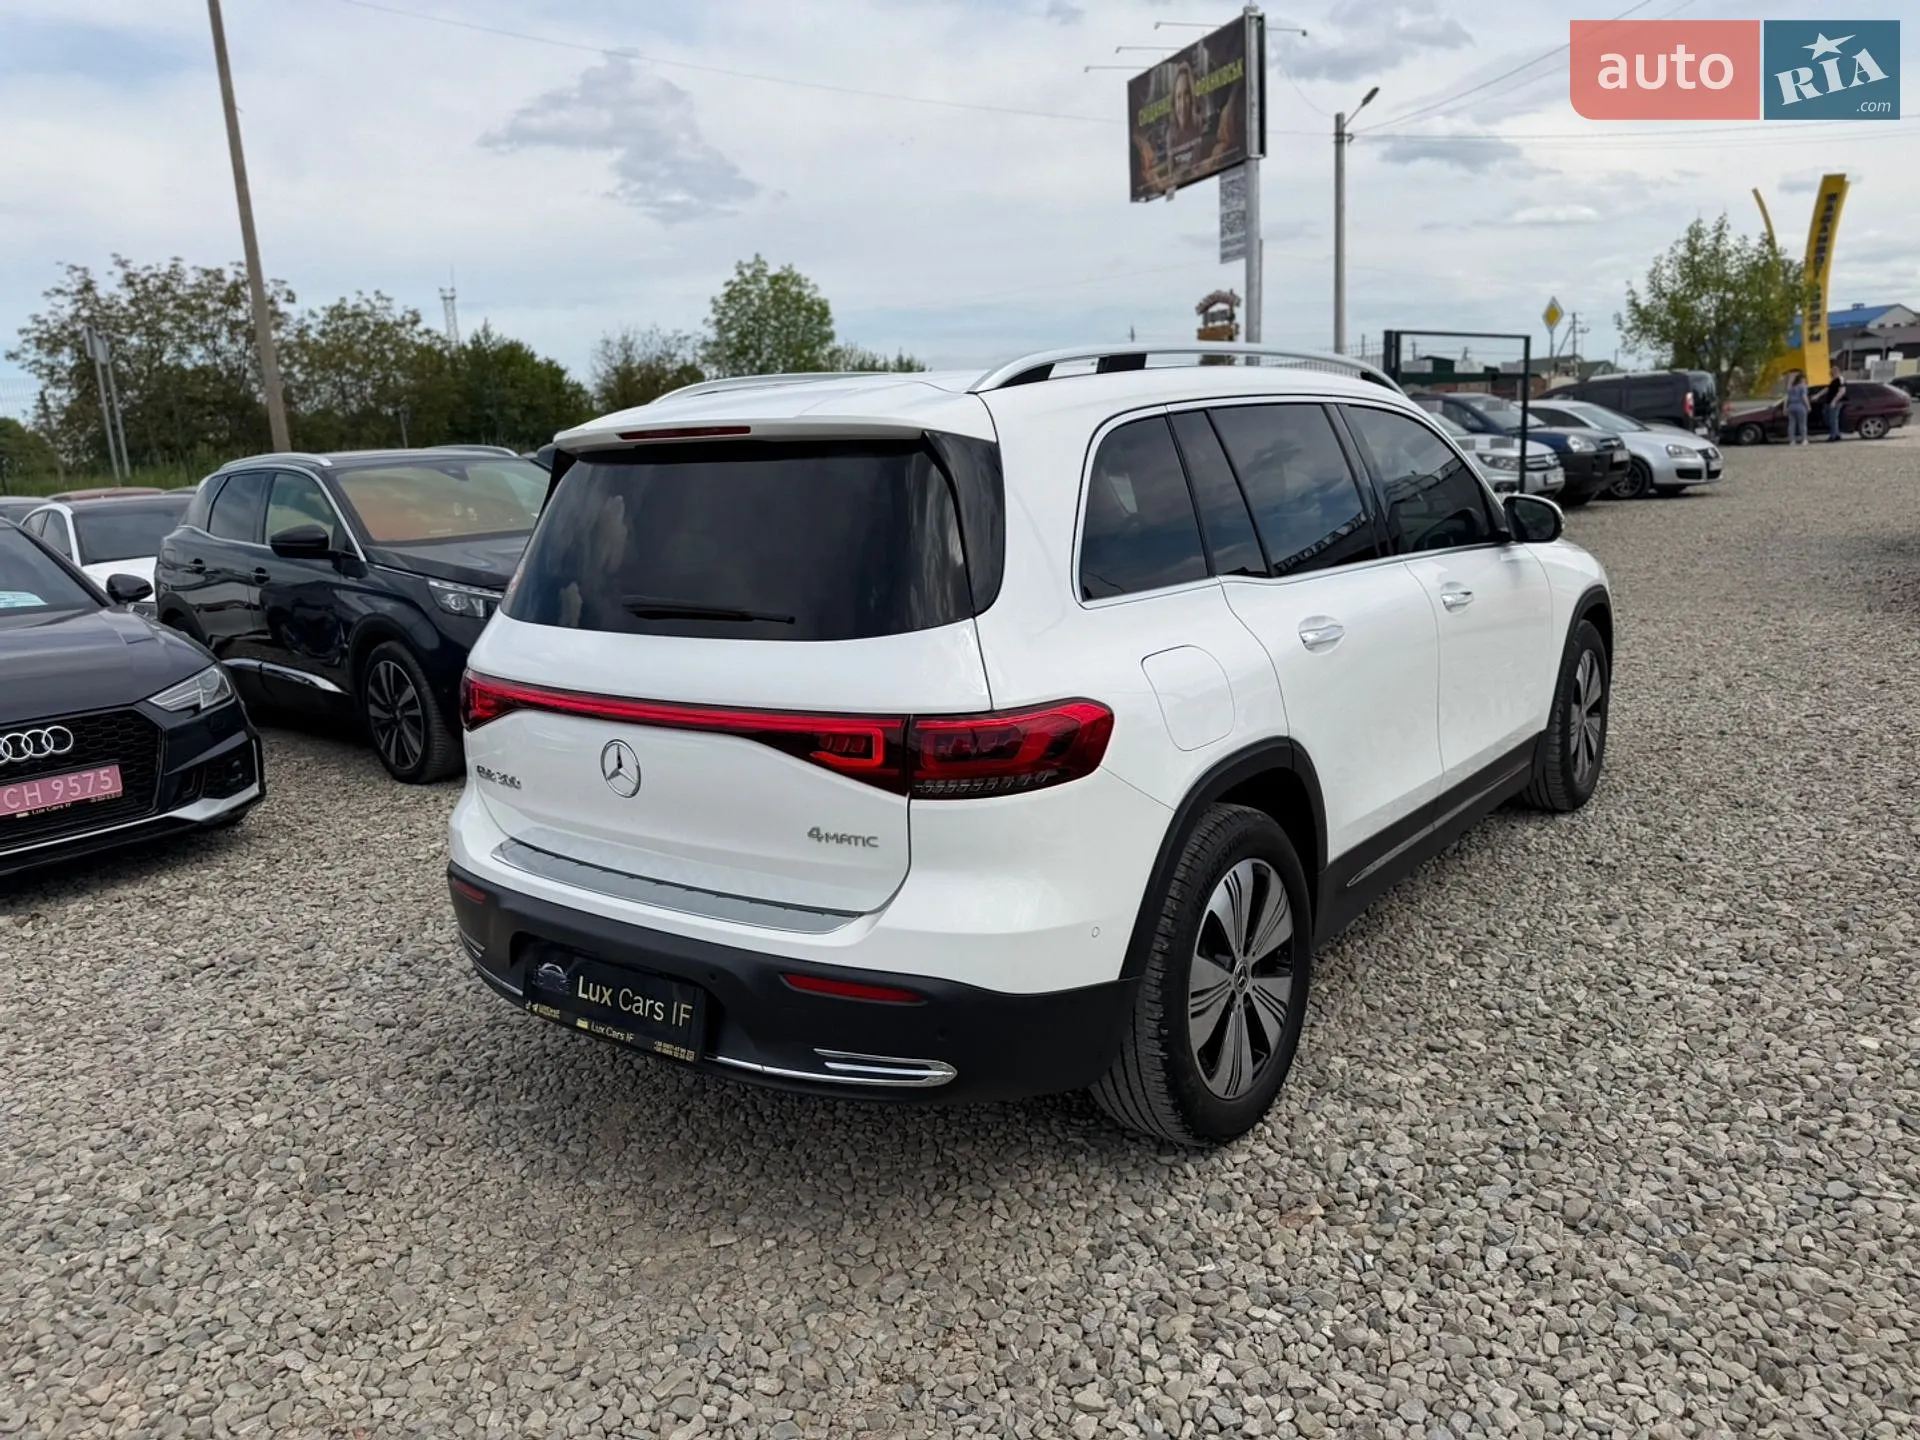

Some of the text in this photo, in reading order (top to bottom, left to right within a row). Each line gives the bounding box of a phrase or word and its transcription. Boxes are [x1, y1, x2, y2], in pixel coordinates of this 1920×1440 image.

[3, 769, 113, 809] CH 9575
[807, 826, 879, 848] 4MATIC
[577, 975, 693, 1027] Lux Cars IF
[591, 1021, 635, 1043] Lux Cars IF
